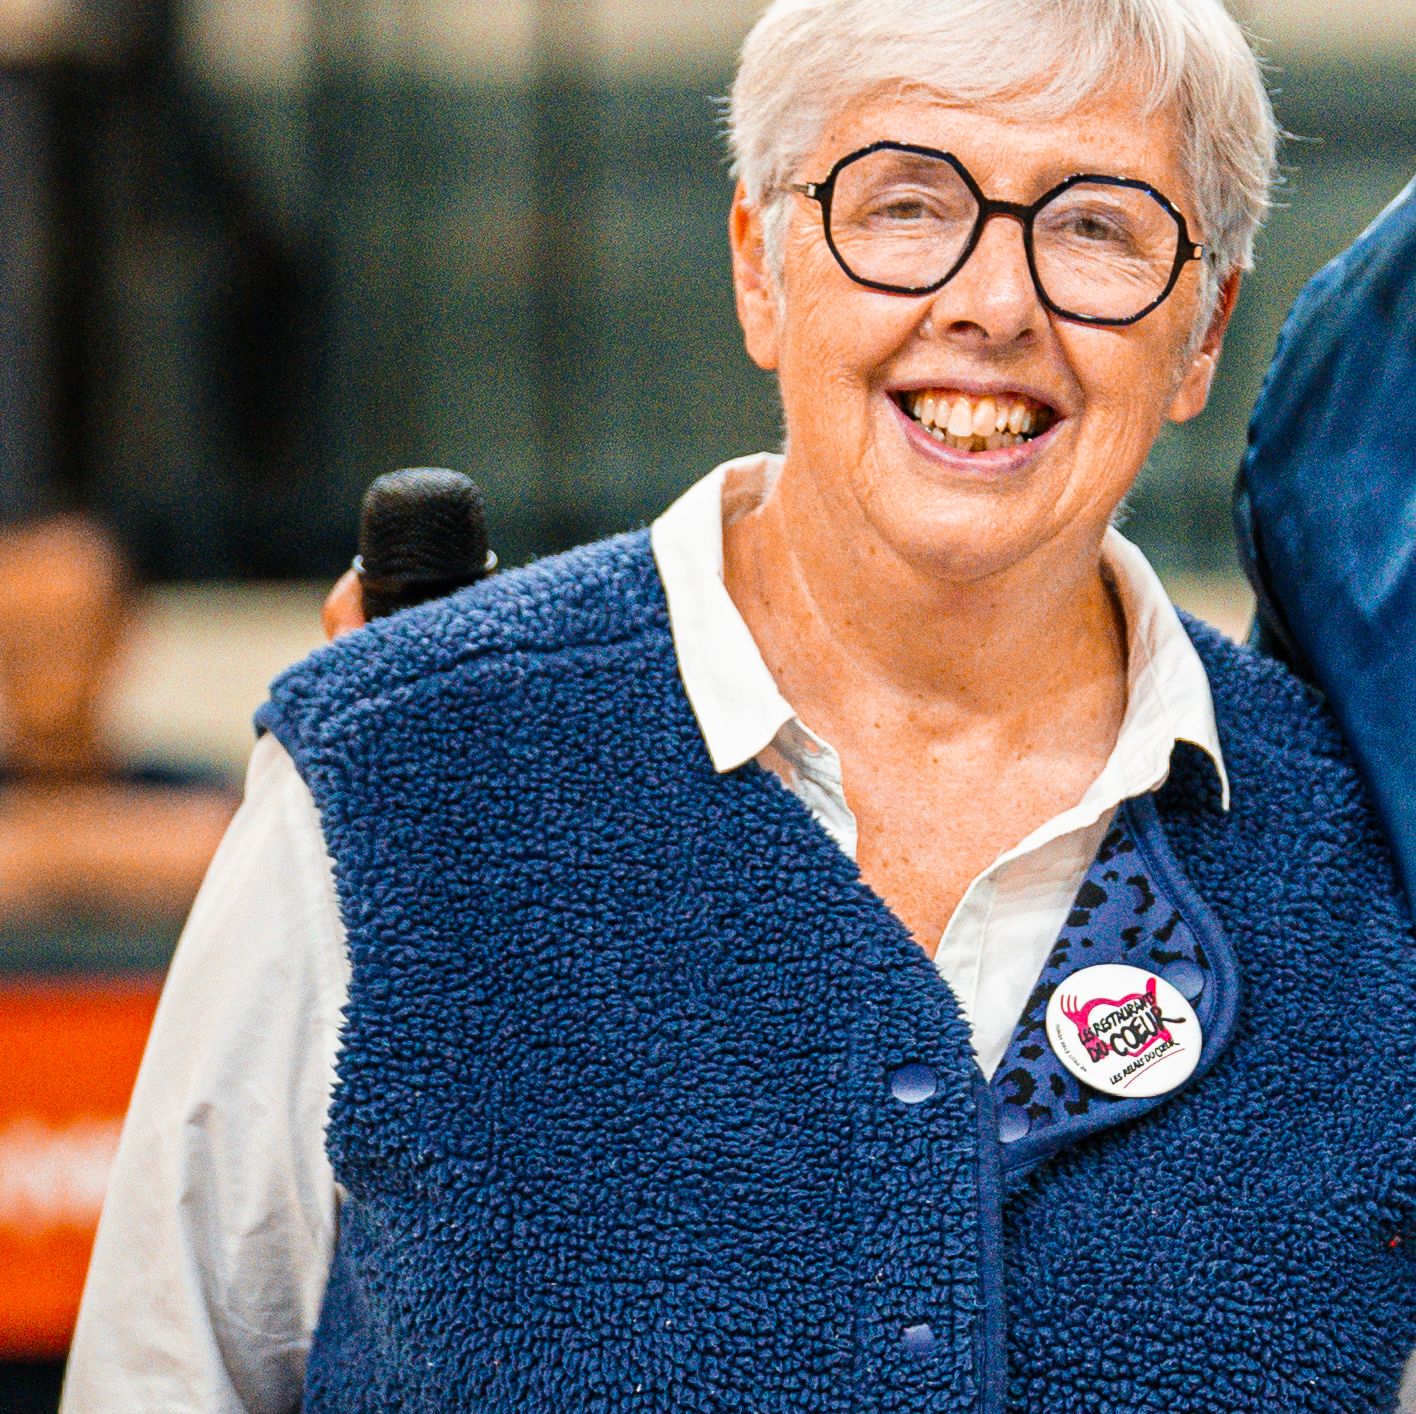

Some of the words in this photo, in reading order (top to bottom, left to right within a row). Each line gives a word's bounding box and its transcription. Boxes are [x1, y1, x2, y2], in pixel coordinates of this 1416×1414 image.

[1078, 1027, 1095, 1046] LES
[1092, 990, 1156, 1037] RESTAURANTS
[1086, 1039, 1110, 1063] DU
[1109, 1072, 1123, 1085] LES
[1122, 1057, 1145, 1077] RELAIS
[1144, 1050, 1156, 1062] DU
